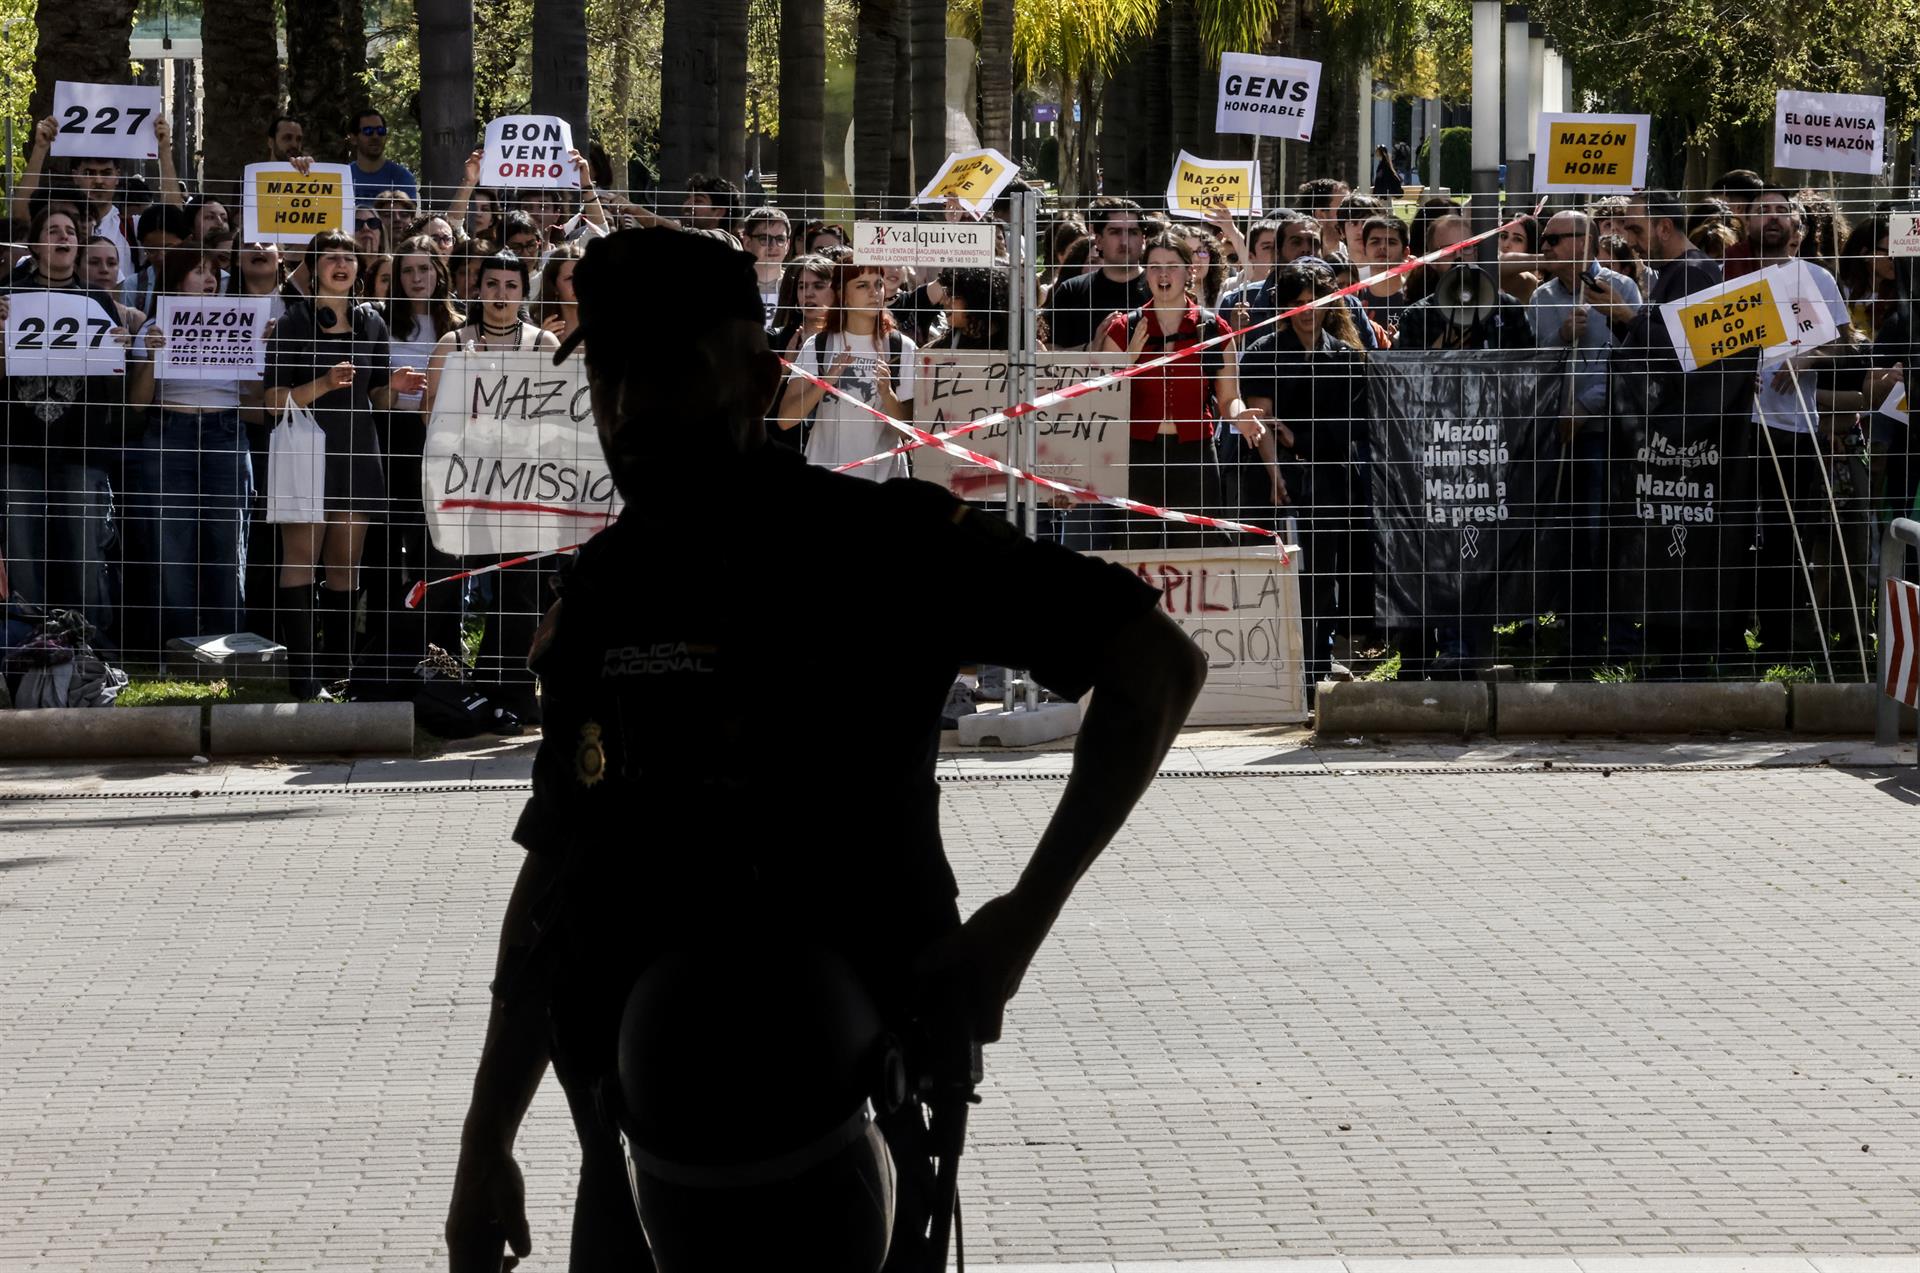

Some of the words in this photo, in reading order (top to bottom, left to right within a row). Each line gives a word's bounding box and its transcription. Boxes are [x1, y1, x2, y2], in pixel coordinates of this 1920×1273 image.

[1225, 75, 1310, 102] GENS
[1224, 101, 1306, 117] HONORABLE
[59, 105, 151, 135] 227
[1785, 113, 1800, 125] EL
[1804, 114, 1831, 127] QUE
[1834, 116, 1876, 130] AVISA
[501, 123, 561, 141] BON
[1560, 130, 1627, 146] MAZÓN
[1784, 133, 1802, 145] NO
[1806, 135, 1823, 147] ES
[1826, 135, 1874, 151] MAZÓN
[501, 145, 563, 160] VENT
[1582, 149, 1603, 159] GO
[499, 163, 563, 178] ORRO
[1564, 162, 1618, 175] HOME
[267, 179, 333, 195] MAZÓN
[1183, 171, 1240, 185] MAZÓN
[1201, 185, 1220, 195] GO
[291, 198, 311, 208] GO
[1190, 193, 1236, 207] HOME
[275, 211, 328, 224] HOME
[892, 227, 978, 247] valquiven
[172, 308, 255, 327] MAZÓN
[1694, 292, 1763, 328] MAZÓN
[15, 317, 111, 349] 227
[1723, 318, 1745, 333] GO
[171, 328, 253, 343] PORTES
[1711, 325, 1767, 356] HOME
[171, 343, 198, 354] MÉS
[202, 345, 254, 355] POLICIA
[171, 356, 198, 366] QUE
[202, 357, 254, 366] FRANCO
[931, 362, 973, 402] EL
[929, 407, 946, 435] A
[1433, 419, 1497, 442] Mazón
[1651, 431, 1709, 456] Mazón
[1423, 441, 1509, 467] dimissió
[1637, 444, 1719, 468] dimissió
[1425, 477, 1490, 500] Mazón
[1496, 481, 1506, 497] a
[1636, 473, 1699, 498] Mazón
[1704, 482, 1714, 498] a
[1426, 502, 1446, 523] la
[1452, 498, 1508, 527] presó
[1636, 497, 1654, 519] la
[1661, 501, 1714, 525] presó
[604, 641, 688, 661] POLICIA
[601, 658, 714, 678] NACIONAL
